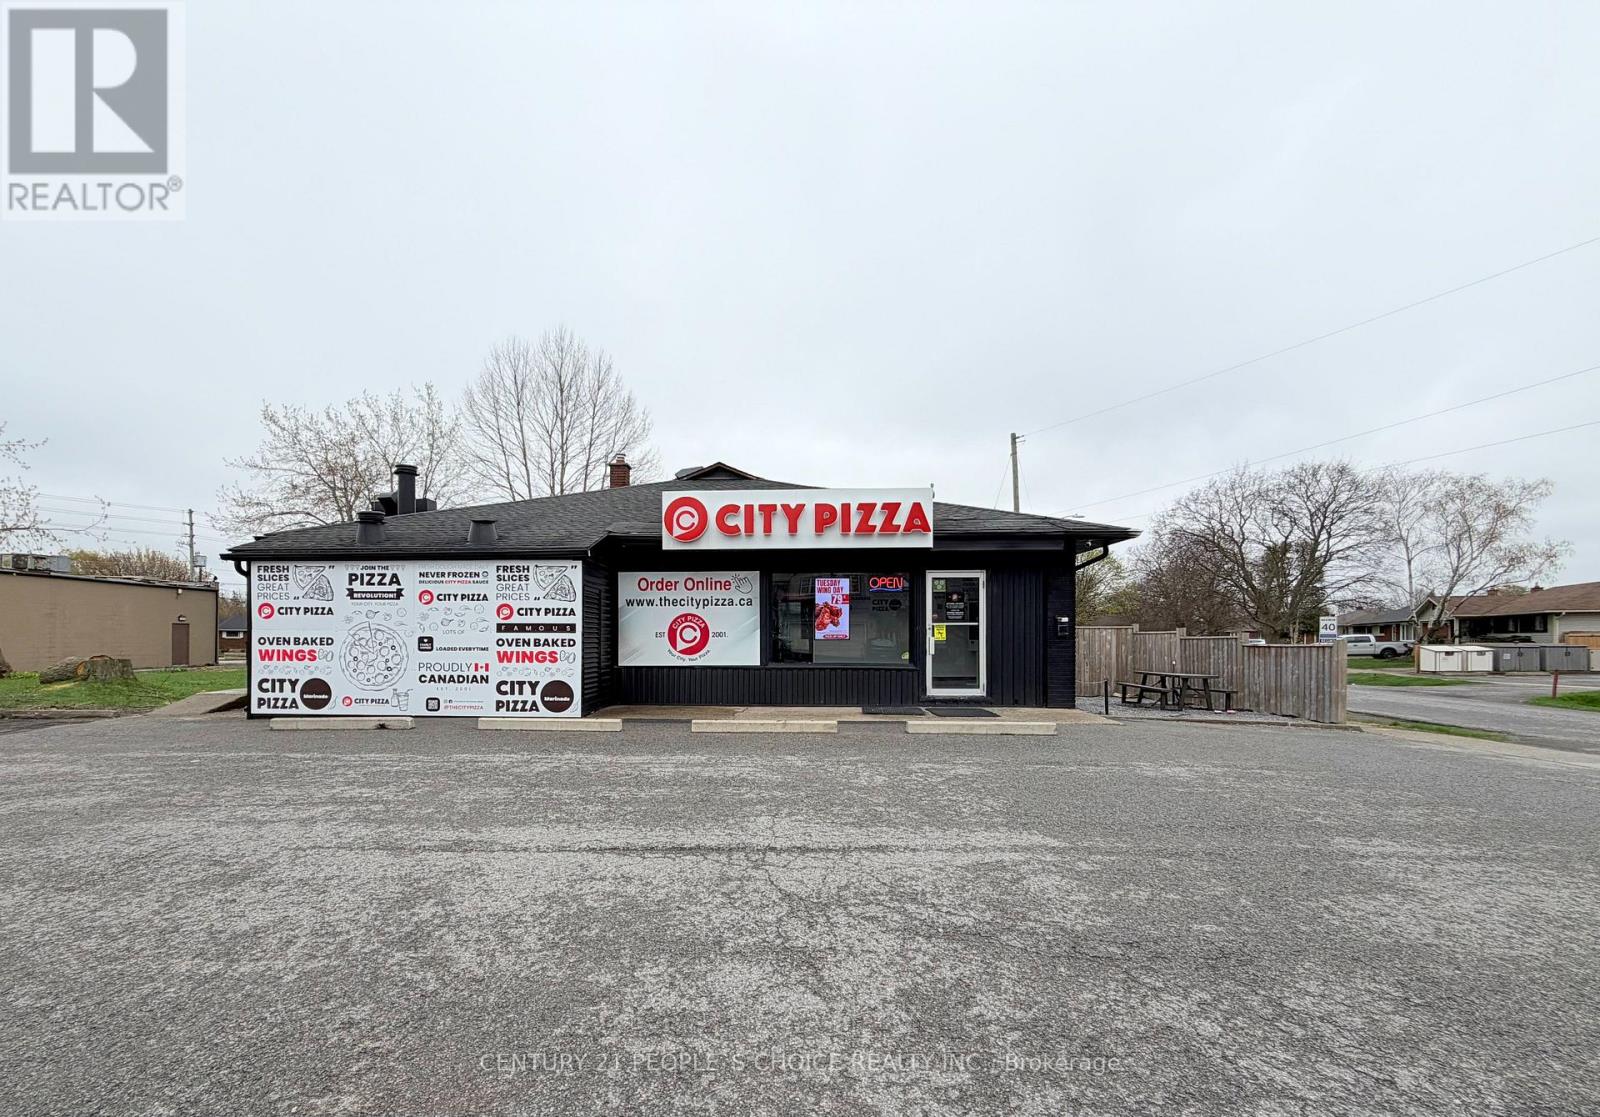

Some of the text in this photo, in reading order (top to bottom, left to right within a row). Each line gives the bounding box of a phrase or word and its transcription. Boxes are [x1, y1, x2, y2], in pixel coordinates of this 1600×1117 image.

[715, 502, 932, 537] CITY PIZZA
[257, 565, 290, 573] FRESH
[496, 565, 530, 573] FRESH
[257, 574, 290, 582] SLICES
[348, 572, 402, 586] PIZZA
[496, 574, 530, 582] SLICES
[869, 576, 903, 589] OPEN
[257, 583, 290, 591] GREAT
[496, 583, 530, 592] GREAT
[637, 577, 732, 592] Order Online
[257, 592, 290, 600] PRICES
[436, 593, 489, 601] CITY PIZZA
[496, 592, 530, 601] PRICES
[625, 596, 753, 609] www.thecitypizza.ca
[277, 606, 334, 616] CITY PIZZA
[517, 607, 576, 617] CITY PIZZA
[672, 615, 706, 630] CITY PIZZA
[257, 636, 334, 646] OVEN BAKED
[496, 638, 577, 647] OVEN BAKED
[258, 648, 317, 662] WINGS
[496, 650, 559, 664] WINGS
[418, 662, 473, 672] PROUDLY
[418, 674, 489, 684] CANADIAN
[257, 677, 300, 693] CITY
[495, 680, 540, 696] CITY
[257, 697, 300, 710] PIZZA
[495, 699, 540, 712] PIZZA
